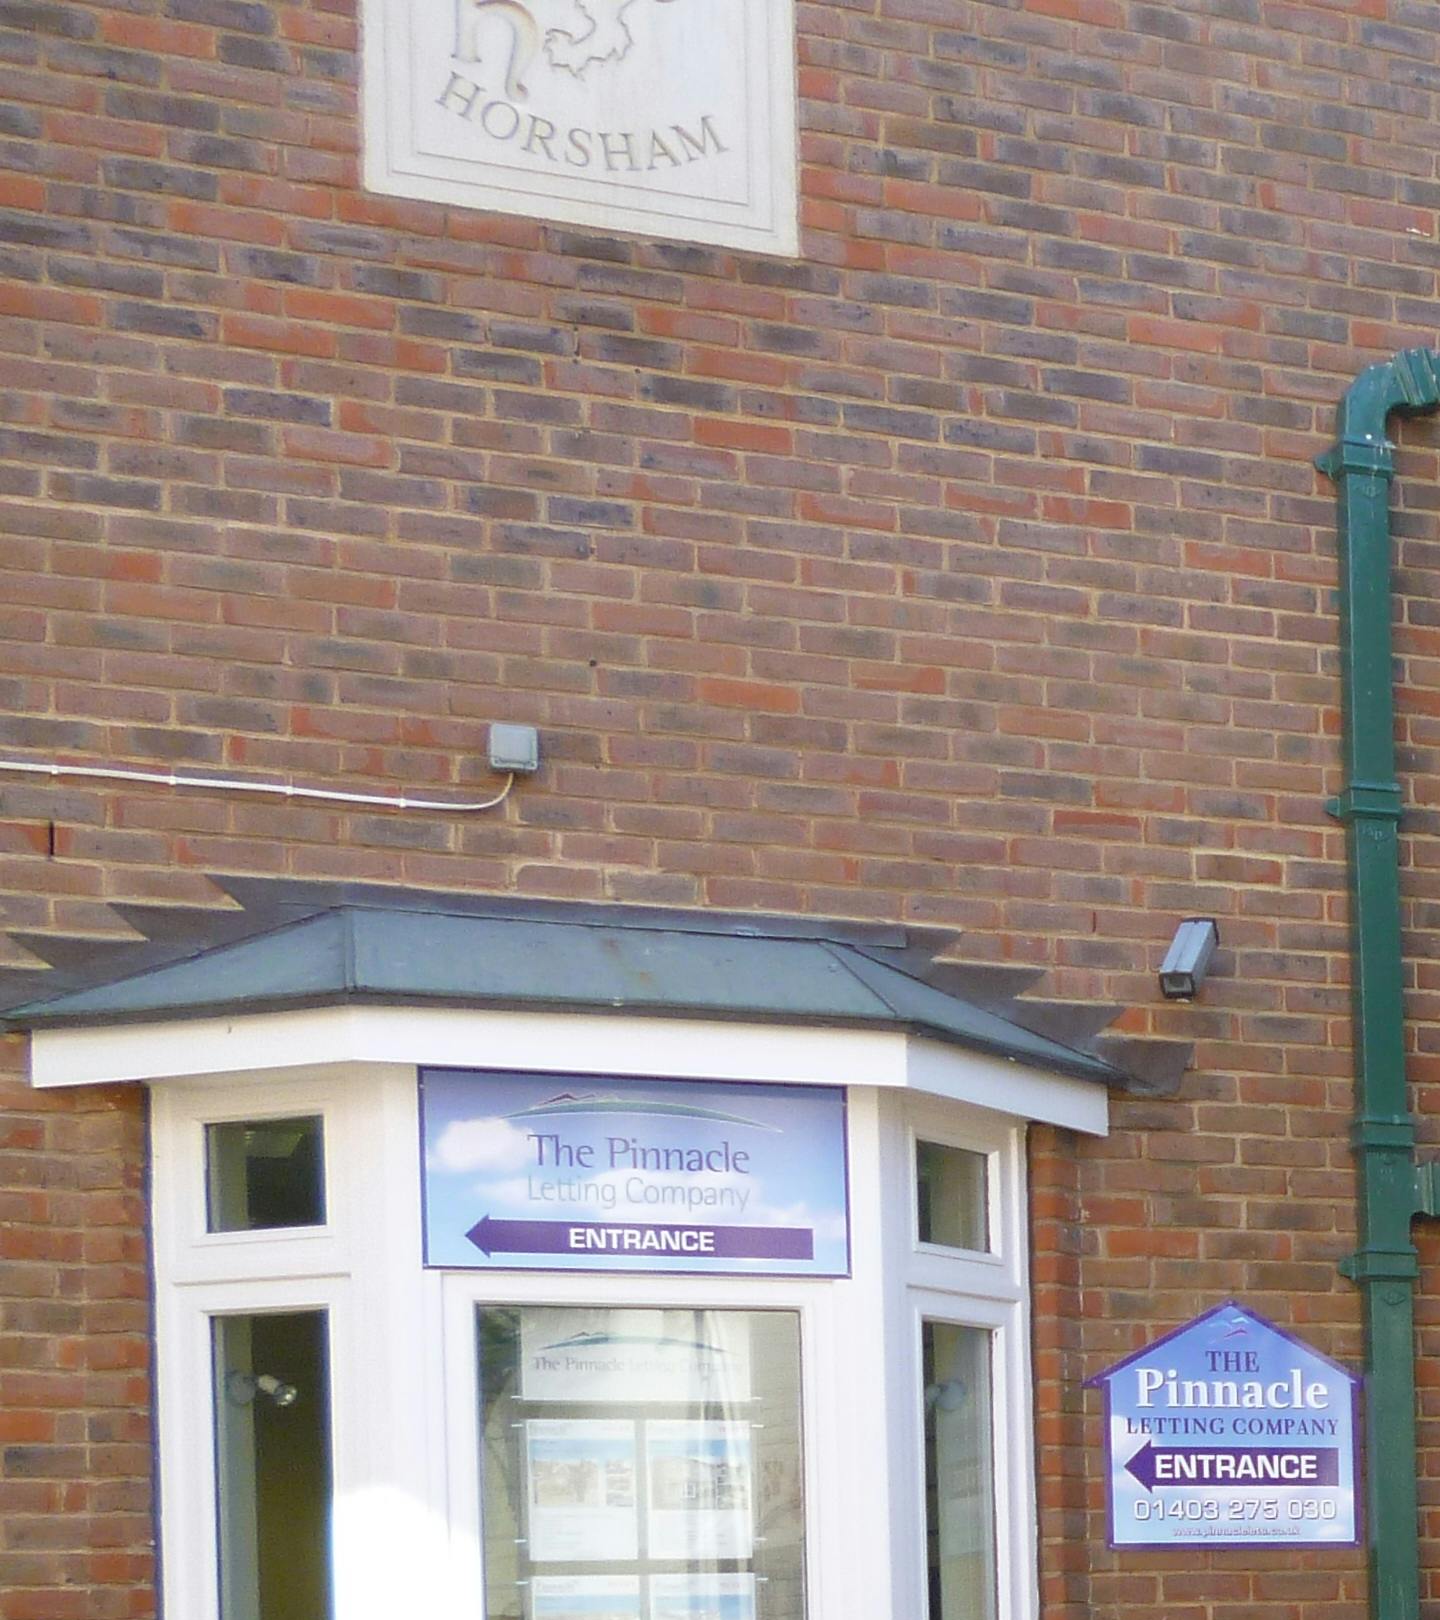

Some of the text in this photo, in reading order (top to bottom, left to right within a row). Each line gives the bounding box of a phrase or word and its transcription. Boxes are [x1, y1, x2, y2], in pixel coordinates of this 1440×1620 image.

[435, 71, 729, 171] HORSHAM
[527, 1134, 751, 1174] The Pinnacle
[527, 1175, 751, 1212] Letting Company
[569, 1227, 715, 1252] ENTRANCE
[1205, 1351, 1260, 1373] THE
[1135, 1368, 1329, 1410] Pinnacle
[1126, 1417, 1339, 1436] LETTING COMPANY
[1155, 1454, 1318, 1479] ENTRANCE
[1134, 1499, 1336, 1521] 01403 275 030
